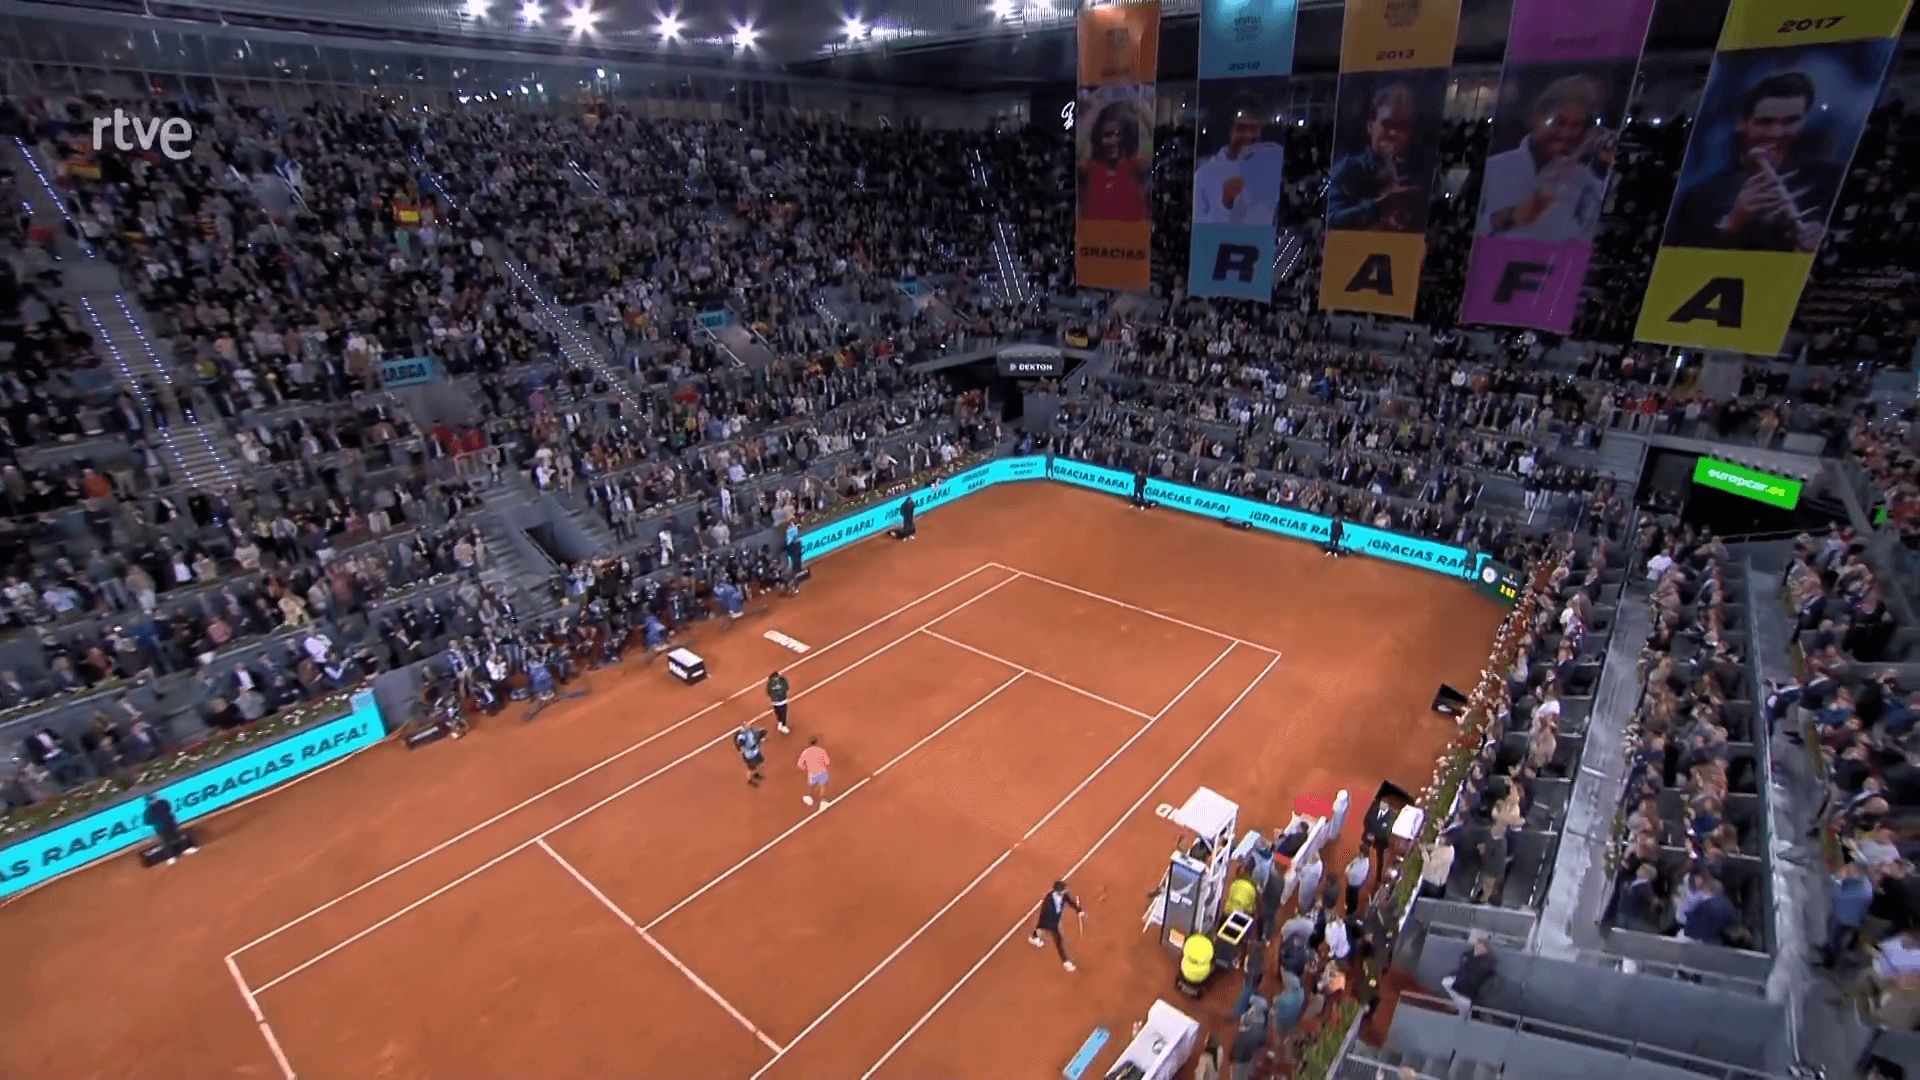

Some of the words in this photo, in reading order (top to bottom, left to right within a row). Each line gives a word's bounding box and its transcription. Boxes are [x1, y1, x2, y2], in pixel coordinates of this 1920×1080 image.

[1777, 15, 1846, 33] 2017
[1212, 243, 1260, 283] R
[1344, 253, 1394, 296] A
[1493, 261, 1556, 303] F
[1667, 276, 1745, 329] A
[174, 752, 296, 812] ¡GRACIAS
[301, 722, 368, 761] RAFA!
